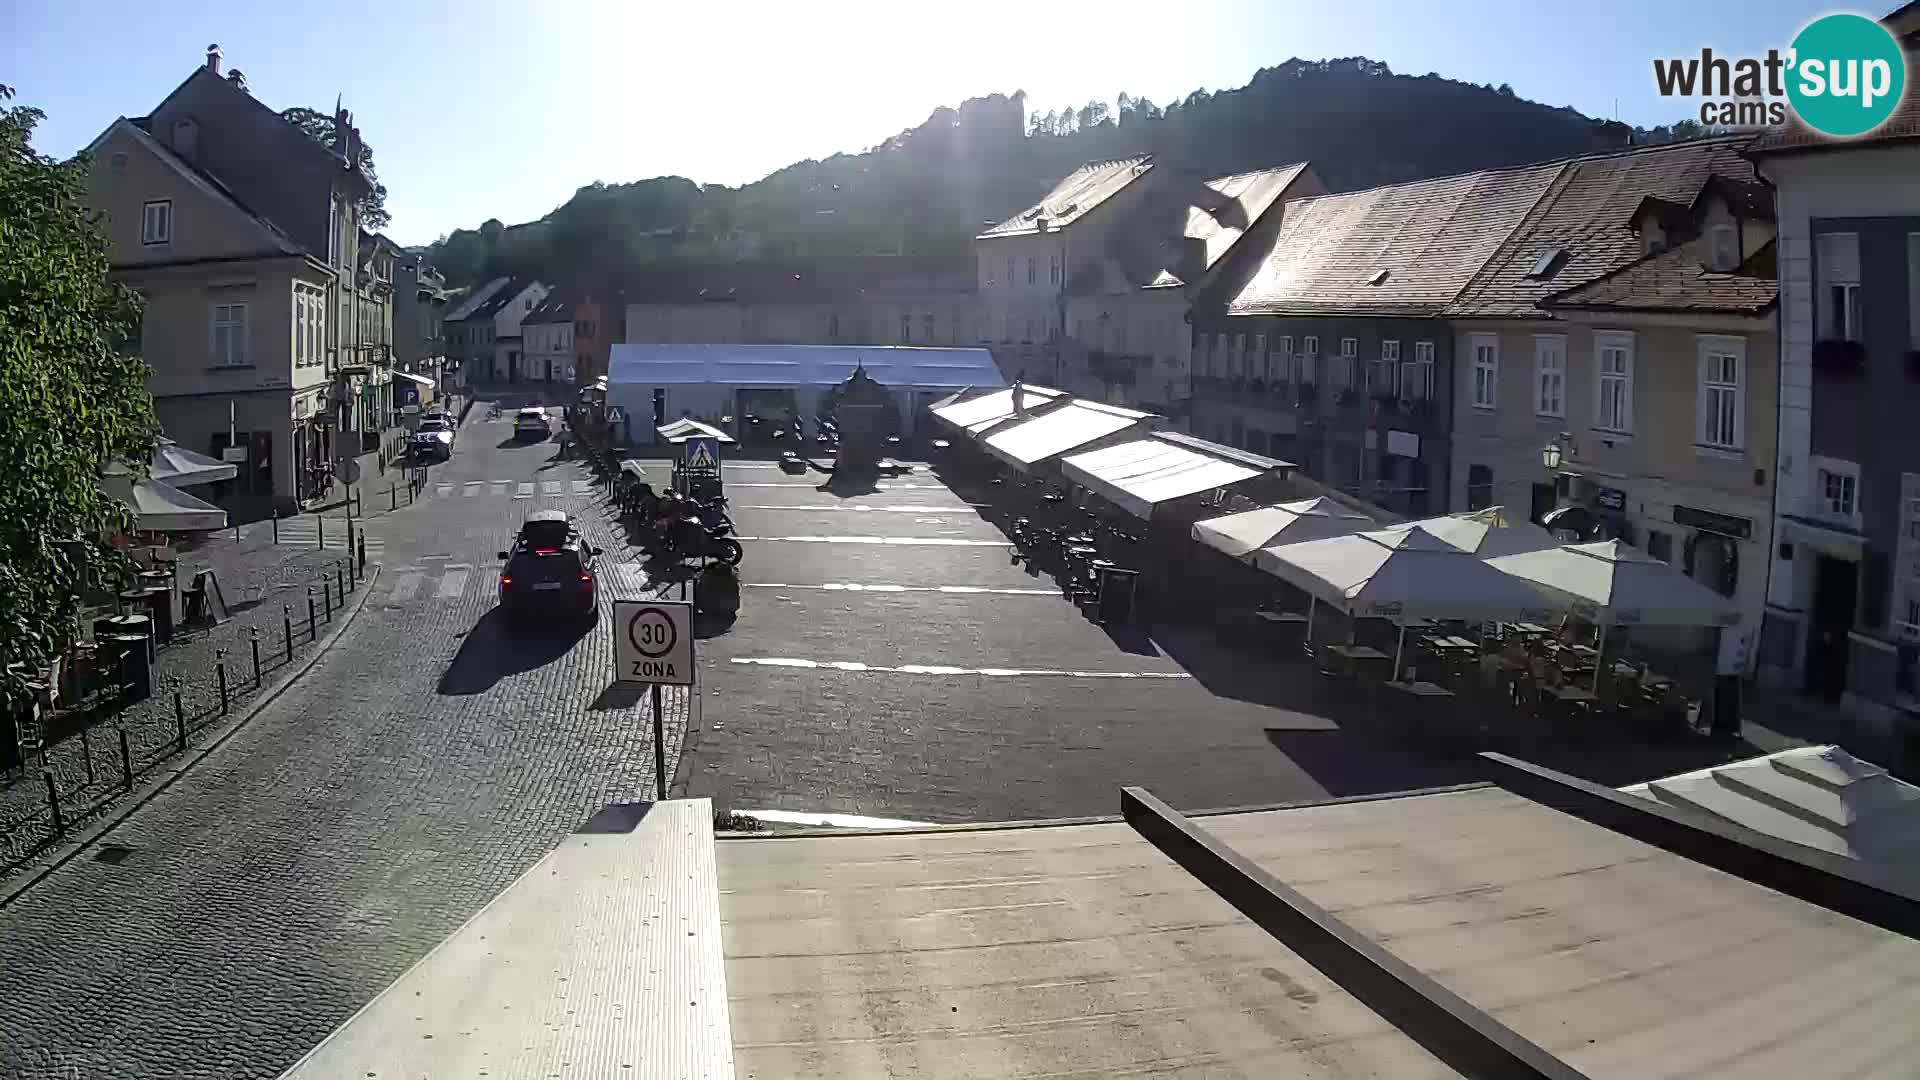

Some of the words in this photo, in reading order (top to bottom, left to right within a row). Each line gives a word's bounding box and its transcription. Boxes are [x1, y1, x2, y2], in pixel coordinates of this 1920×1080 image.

[407, 391, 416, 404] P
[641, 623, 666, 645] 30
[631, 660, 677, 677] ZONA
